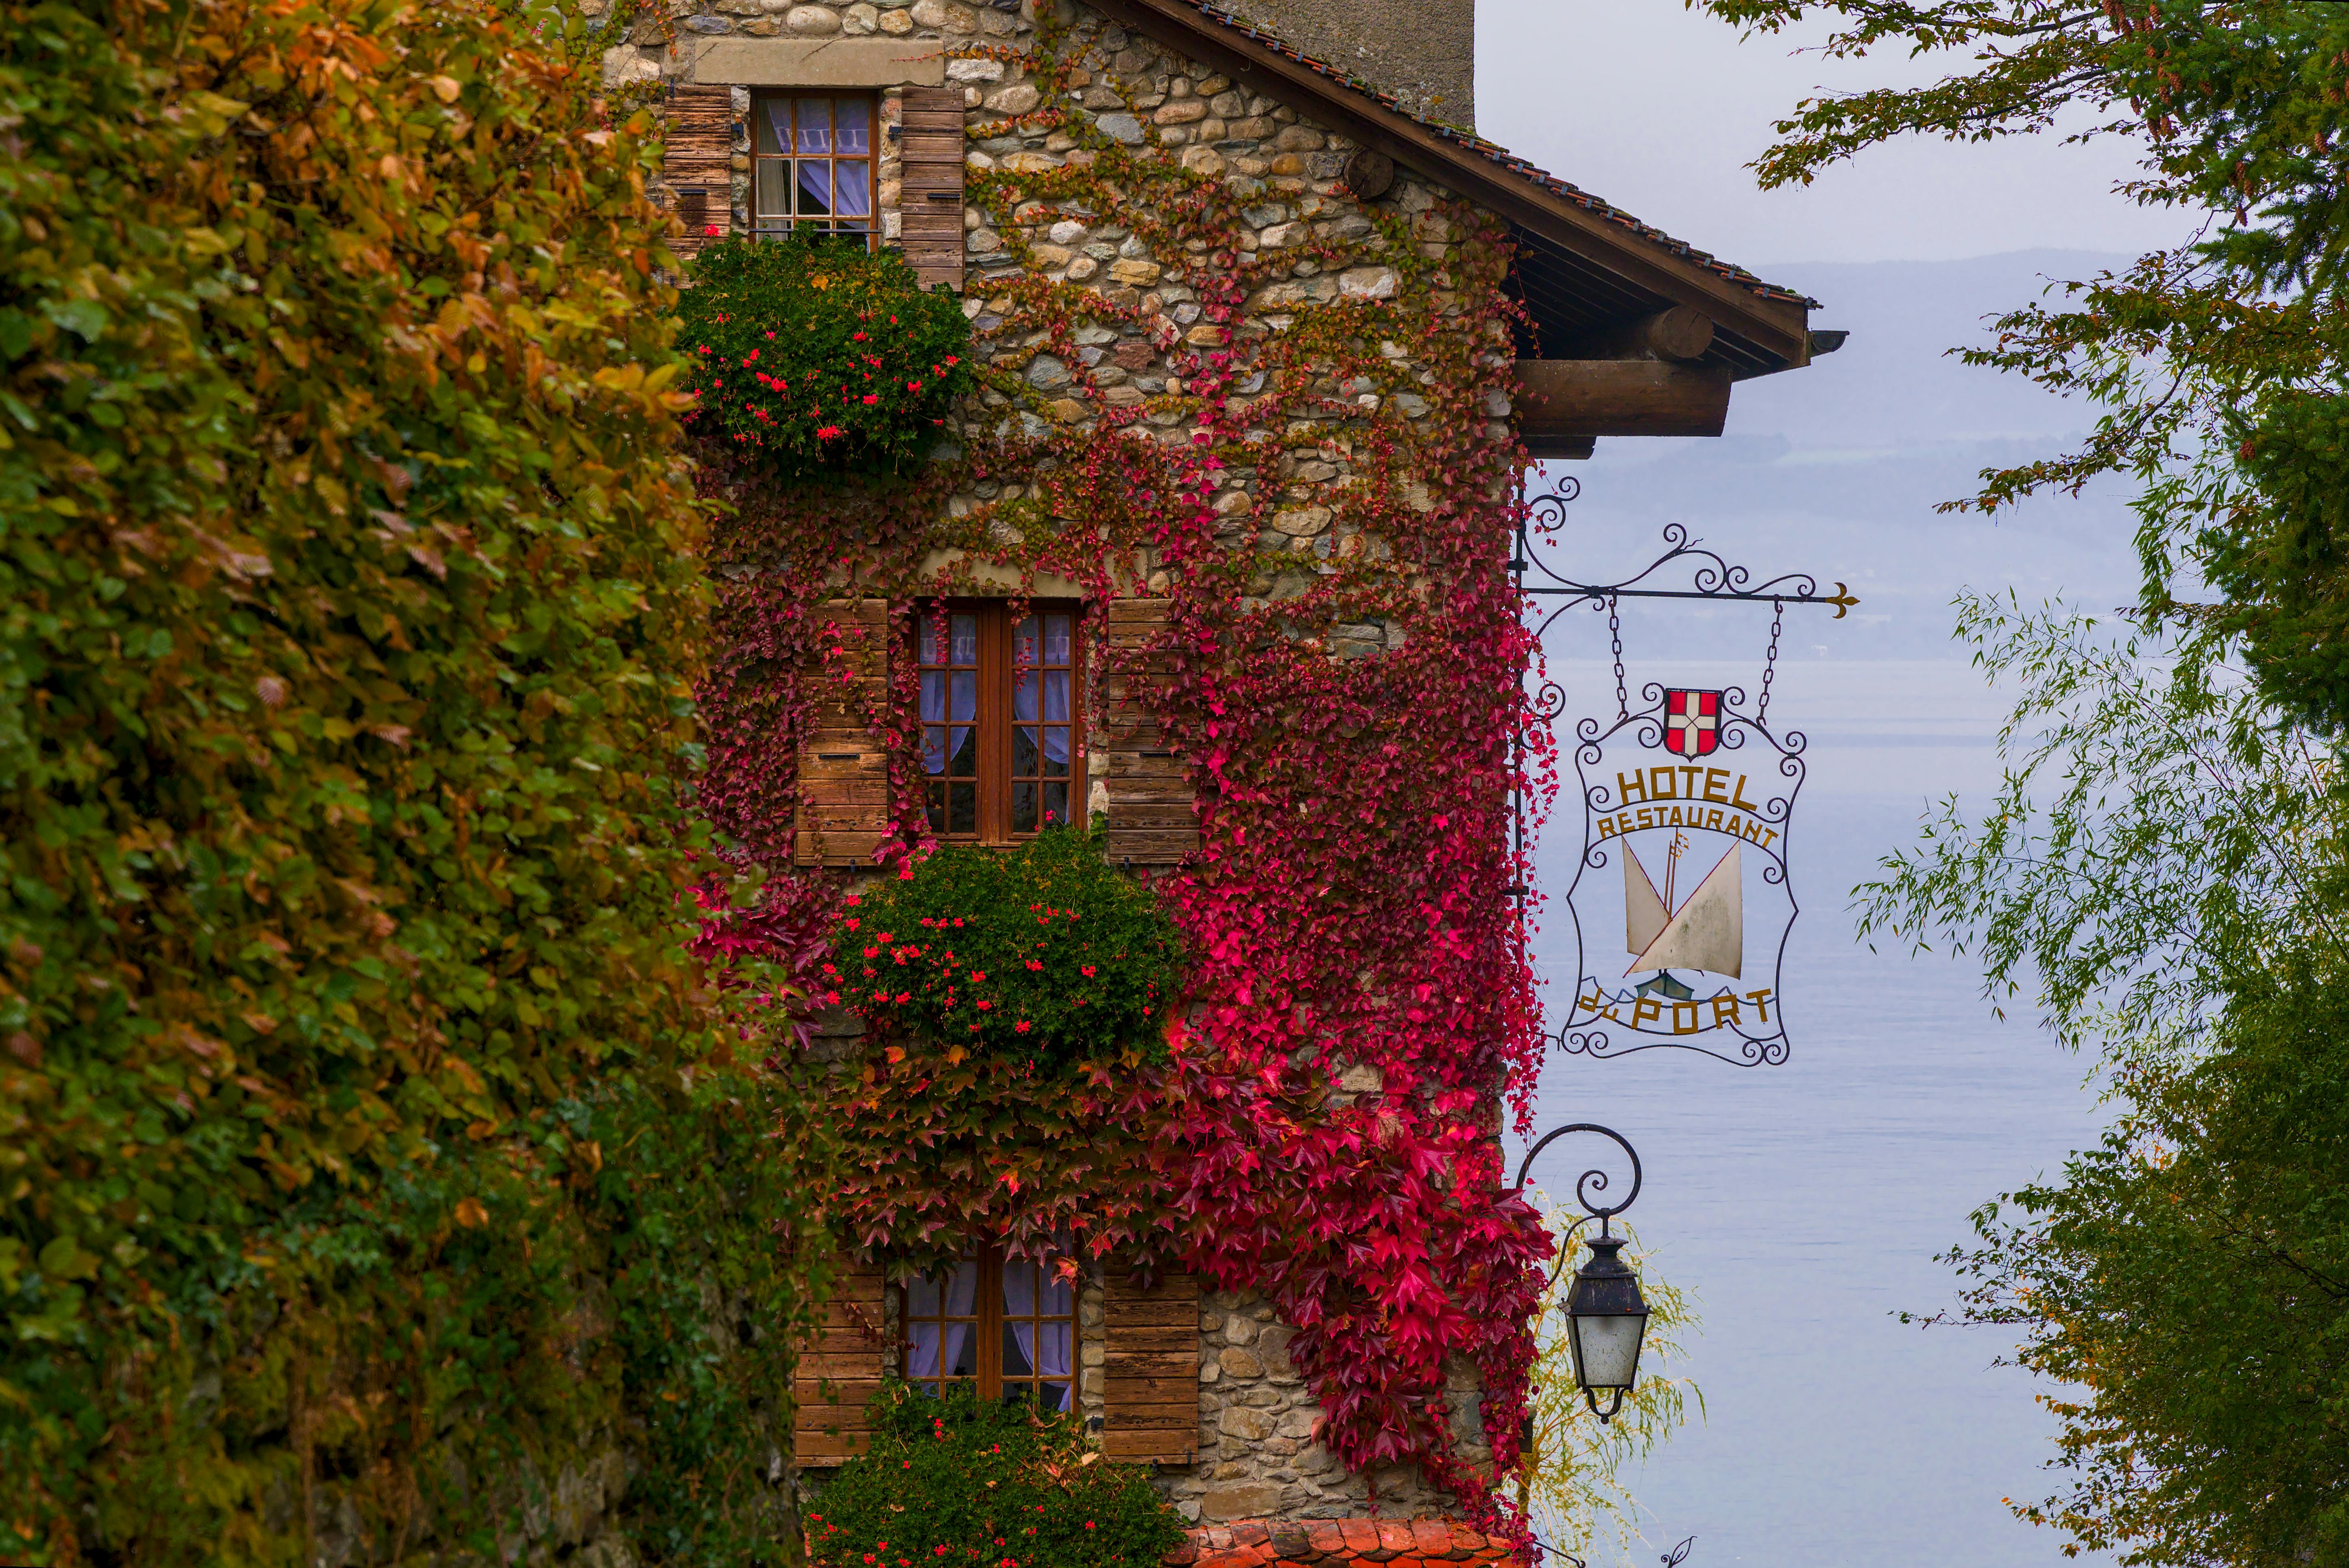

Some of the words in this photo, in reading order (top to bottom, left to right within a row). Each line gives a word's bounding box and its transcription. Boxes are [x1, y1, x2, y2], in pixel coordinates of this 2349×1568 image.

[1617, 766, 1757, 811] HOTEL
[1597, 806, 1779, 848] RESTAURANT
[1631, 989, 1771, 1034] PORT
